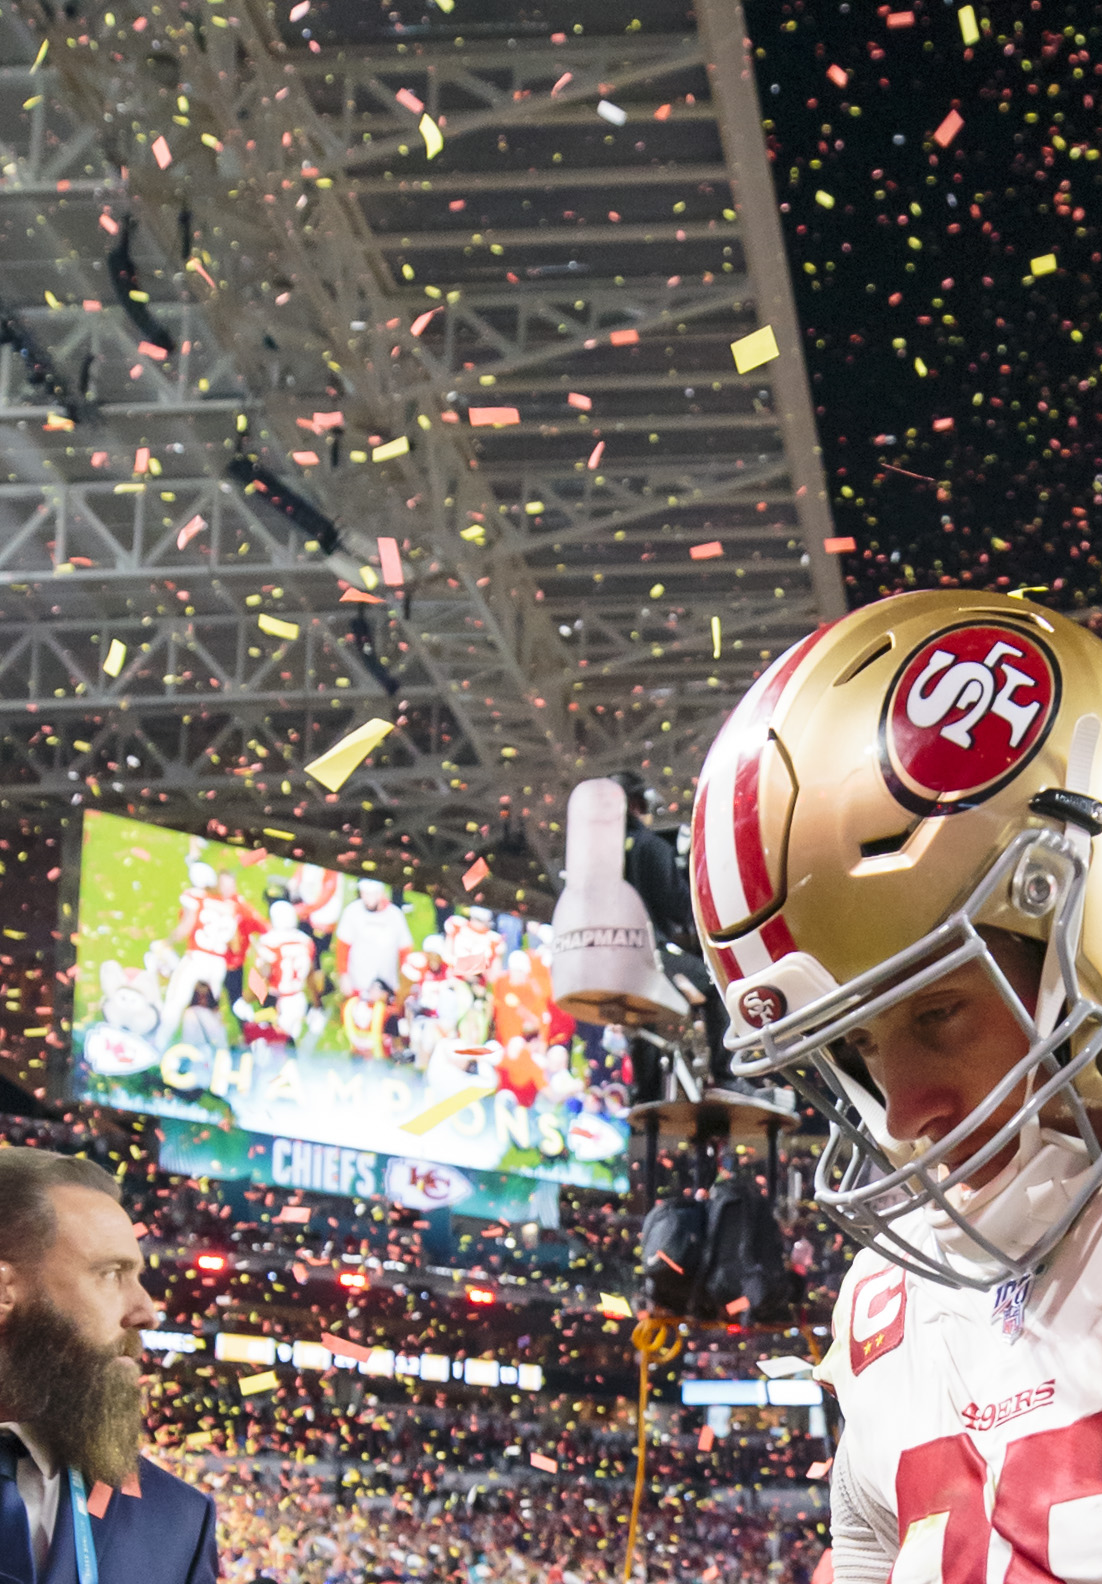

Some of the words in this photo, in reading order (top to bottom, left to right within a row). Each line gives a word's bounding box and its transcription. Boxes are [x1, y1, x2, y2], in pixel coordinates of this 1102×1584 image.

[907, 641, 1041, 749] SF
[553, 926, 645, 953] CHAPMAN
[160, 1042, 566, 1157] CHAMPONS
[271, 1137, 377, 1197] CHIEFS
[852, 1266, 903, 1343] C
[961, 1379, 1056, 1431] 49ERS
